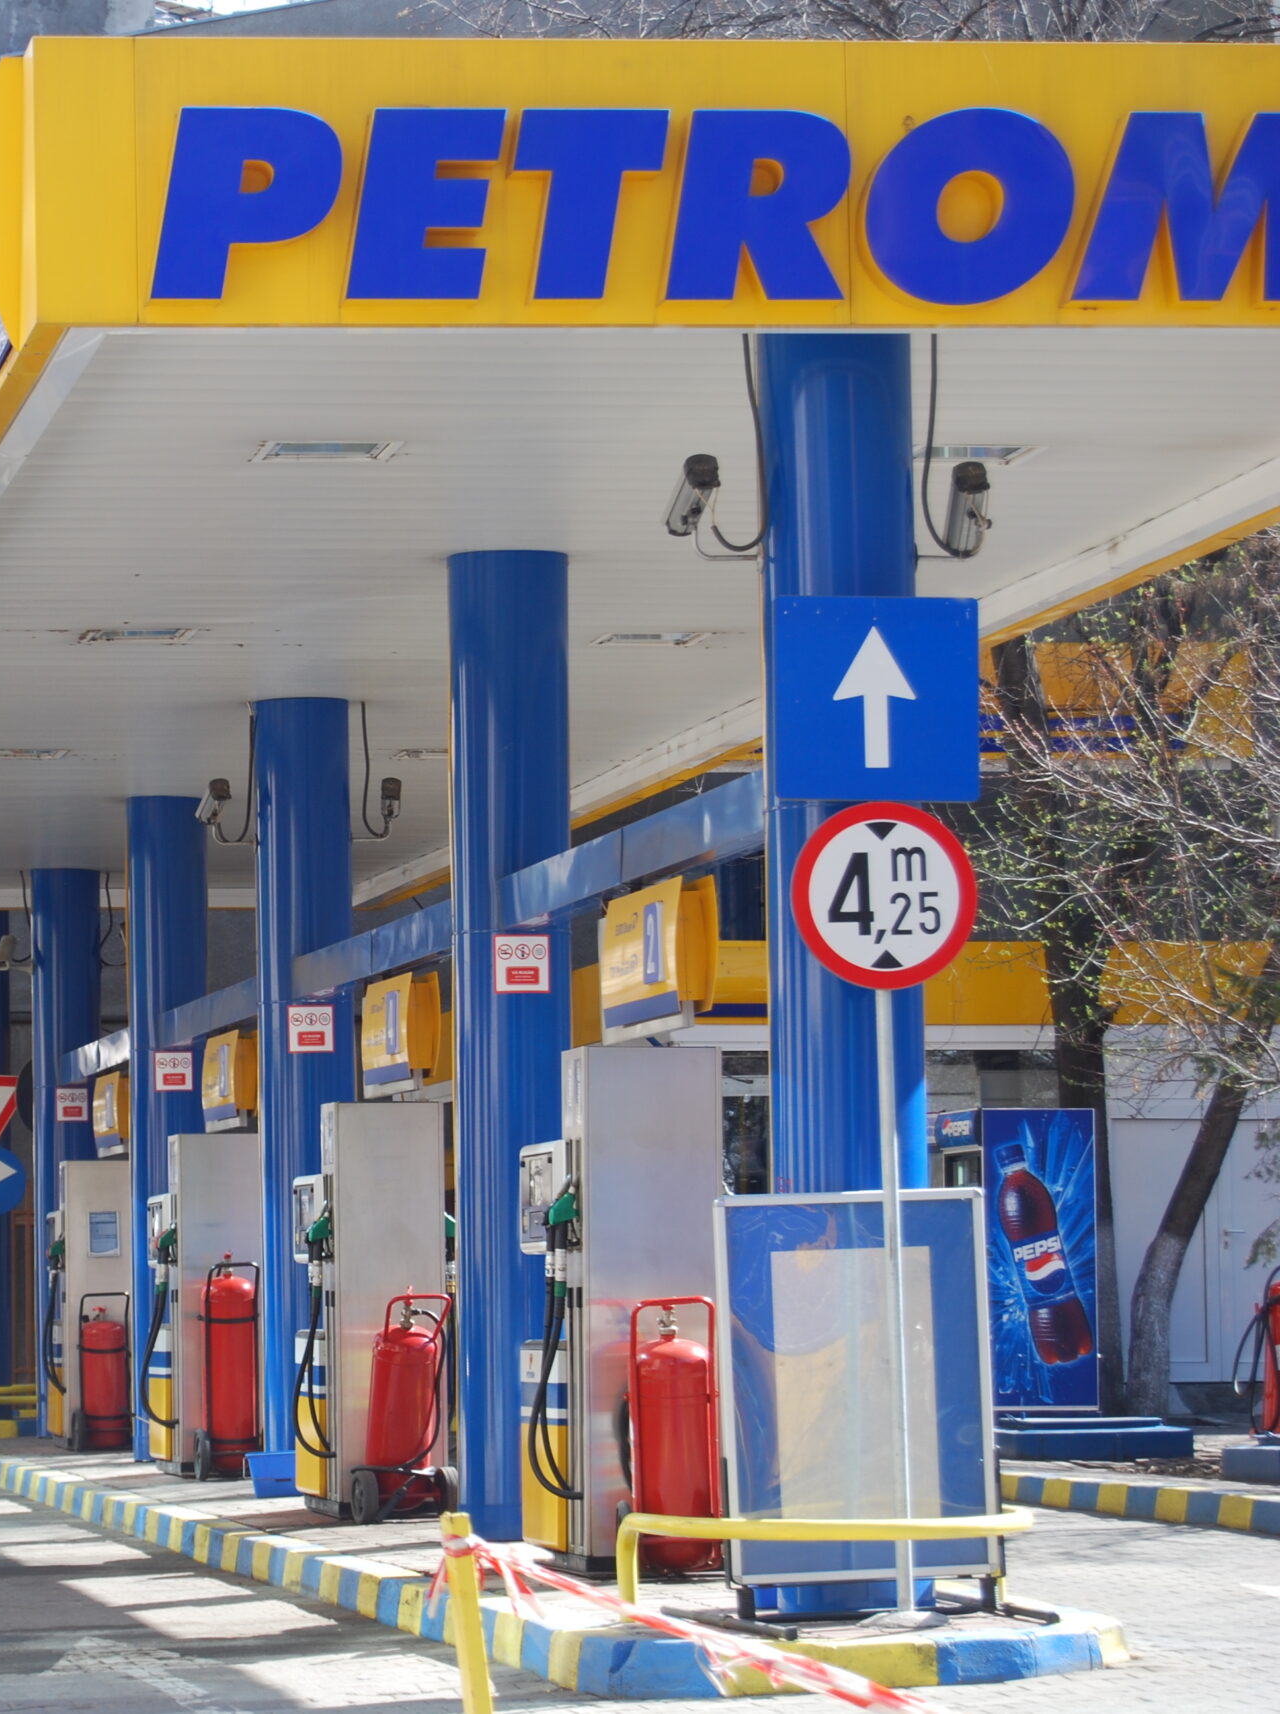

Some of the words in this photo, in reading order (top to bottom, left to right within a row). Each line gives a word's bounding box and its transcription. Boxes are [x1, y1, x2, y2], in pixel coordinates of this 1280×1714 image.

[150, 106, 1280, 306] PETROM
[891, 846, 927, 882] m
[646, 913, 656, 974] 2
[947, 1120, 971, 1136] PEPSI
[1013, 1235, 1062, 1262] PEPSI
